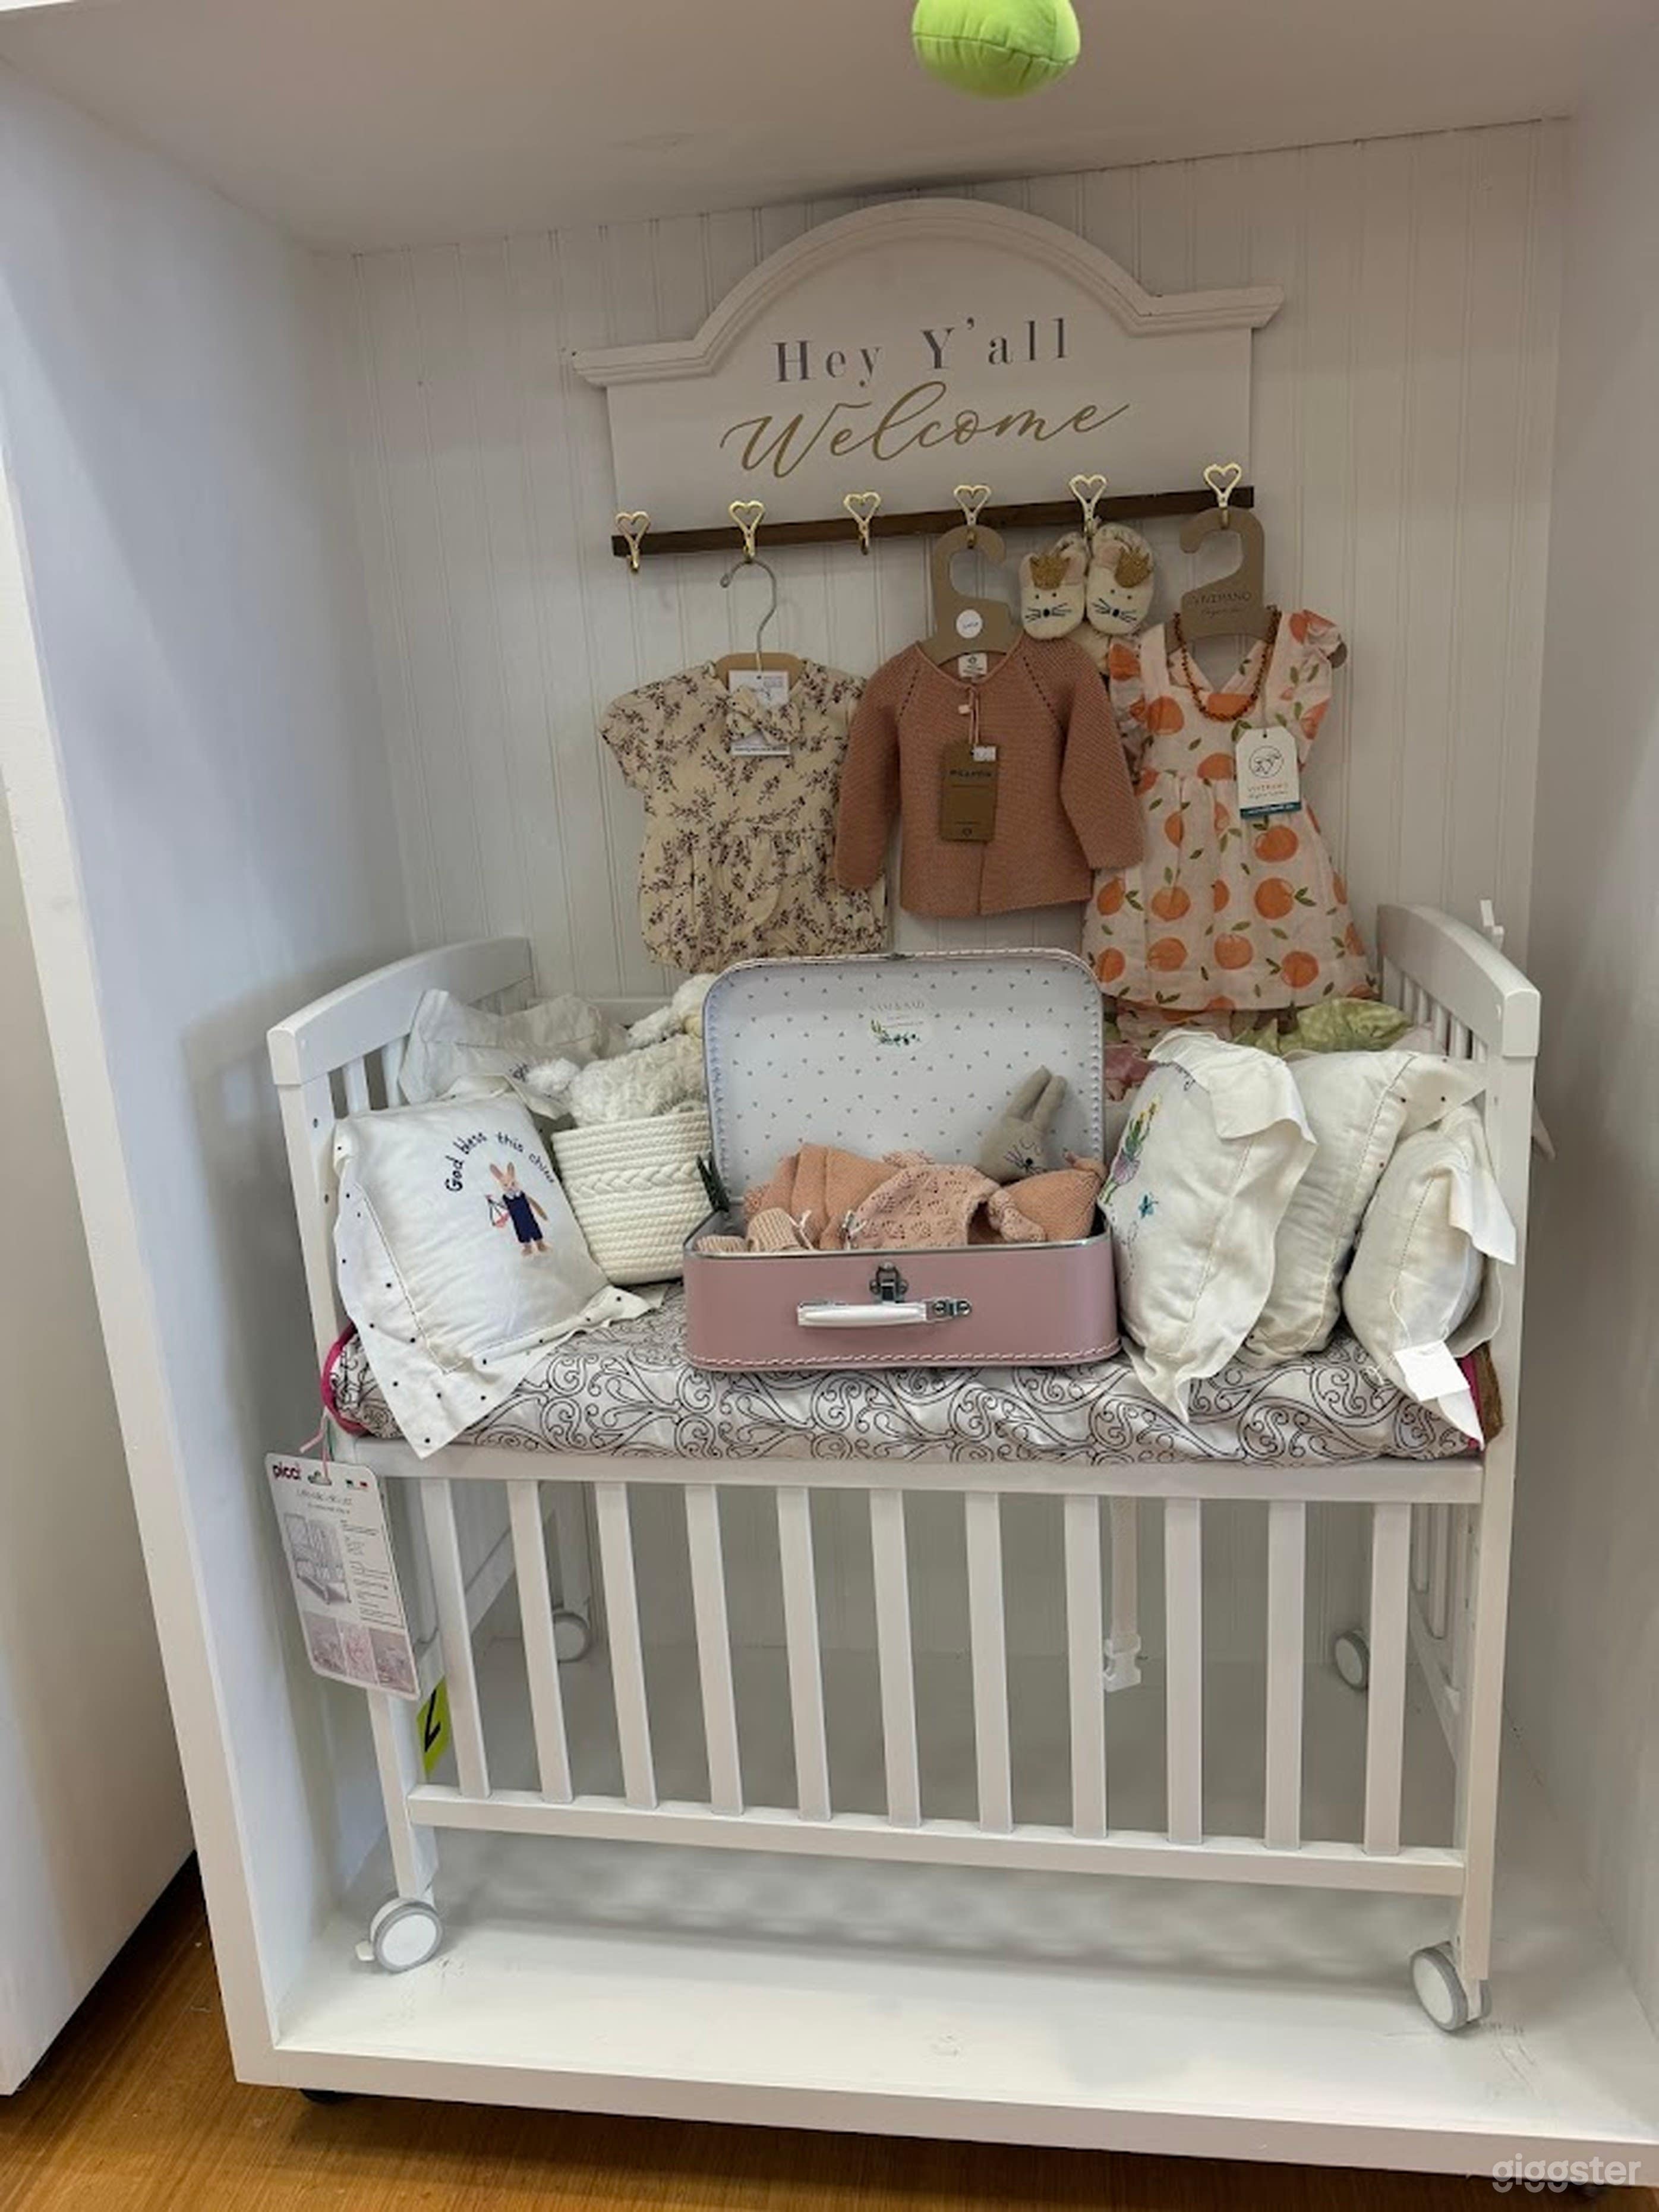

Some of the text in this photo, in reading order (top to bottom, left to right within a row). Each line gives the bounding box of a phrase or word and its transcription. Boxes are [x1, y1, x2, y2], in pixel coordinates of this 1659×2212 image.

[774, 317, 1070, 387] Hey Y'all
[719, 380, 1130, 478] Welcome
[453, 1132, 487, 1154] bless
[495, 1131, 523, 1153] this
[445, 1155, 464, 1192] God
